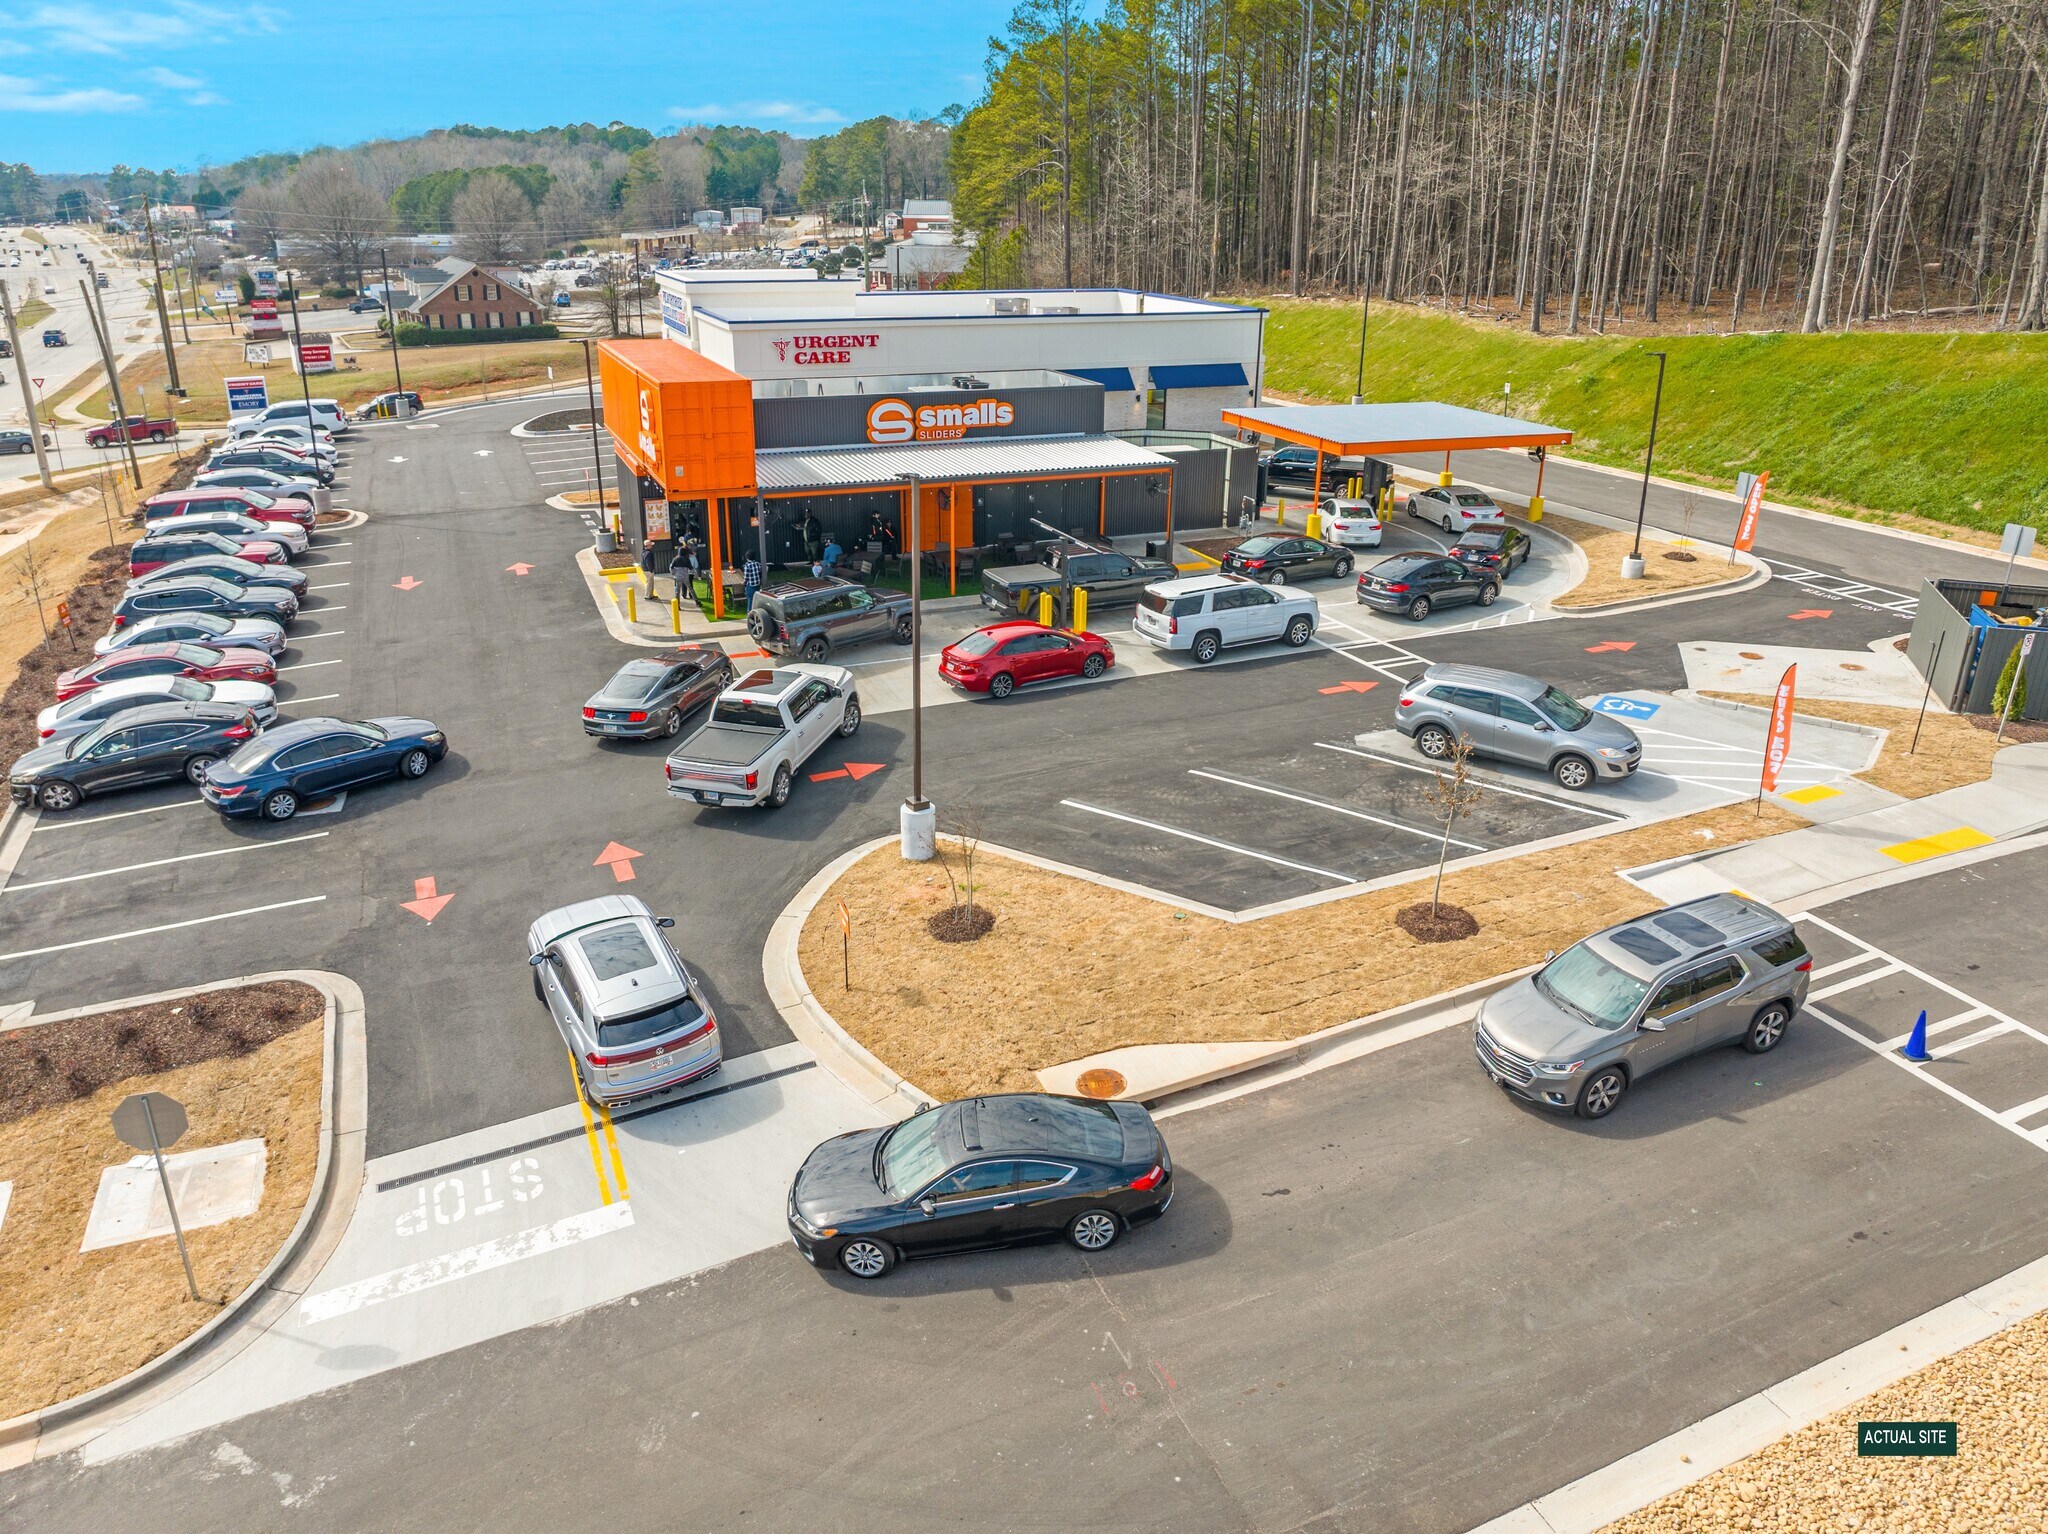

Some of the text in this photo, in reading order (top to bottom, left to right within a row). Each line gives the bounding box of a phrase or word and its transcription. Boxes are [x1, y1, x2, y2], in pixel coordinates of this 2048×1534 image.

[793, 334, 880, 349] URGENT
[794, 350, 852, 365] CARE
[919, 403, 1014, 428] smalls
[919, 429, 963, 439] SLIDERS
[395, 1157, 544, 1237] STOP
